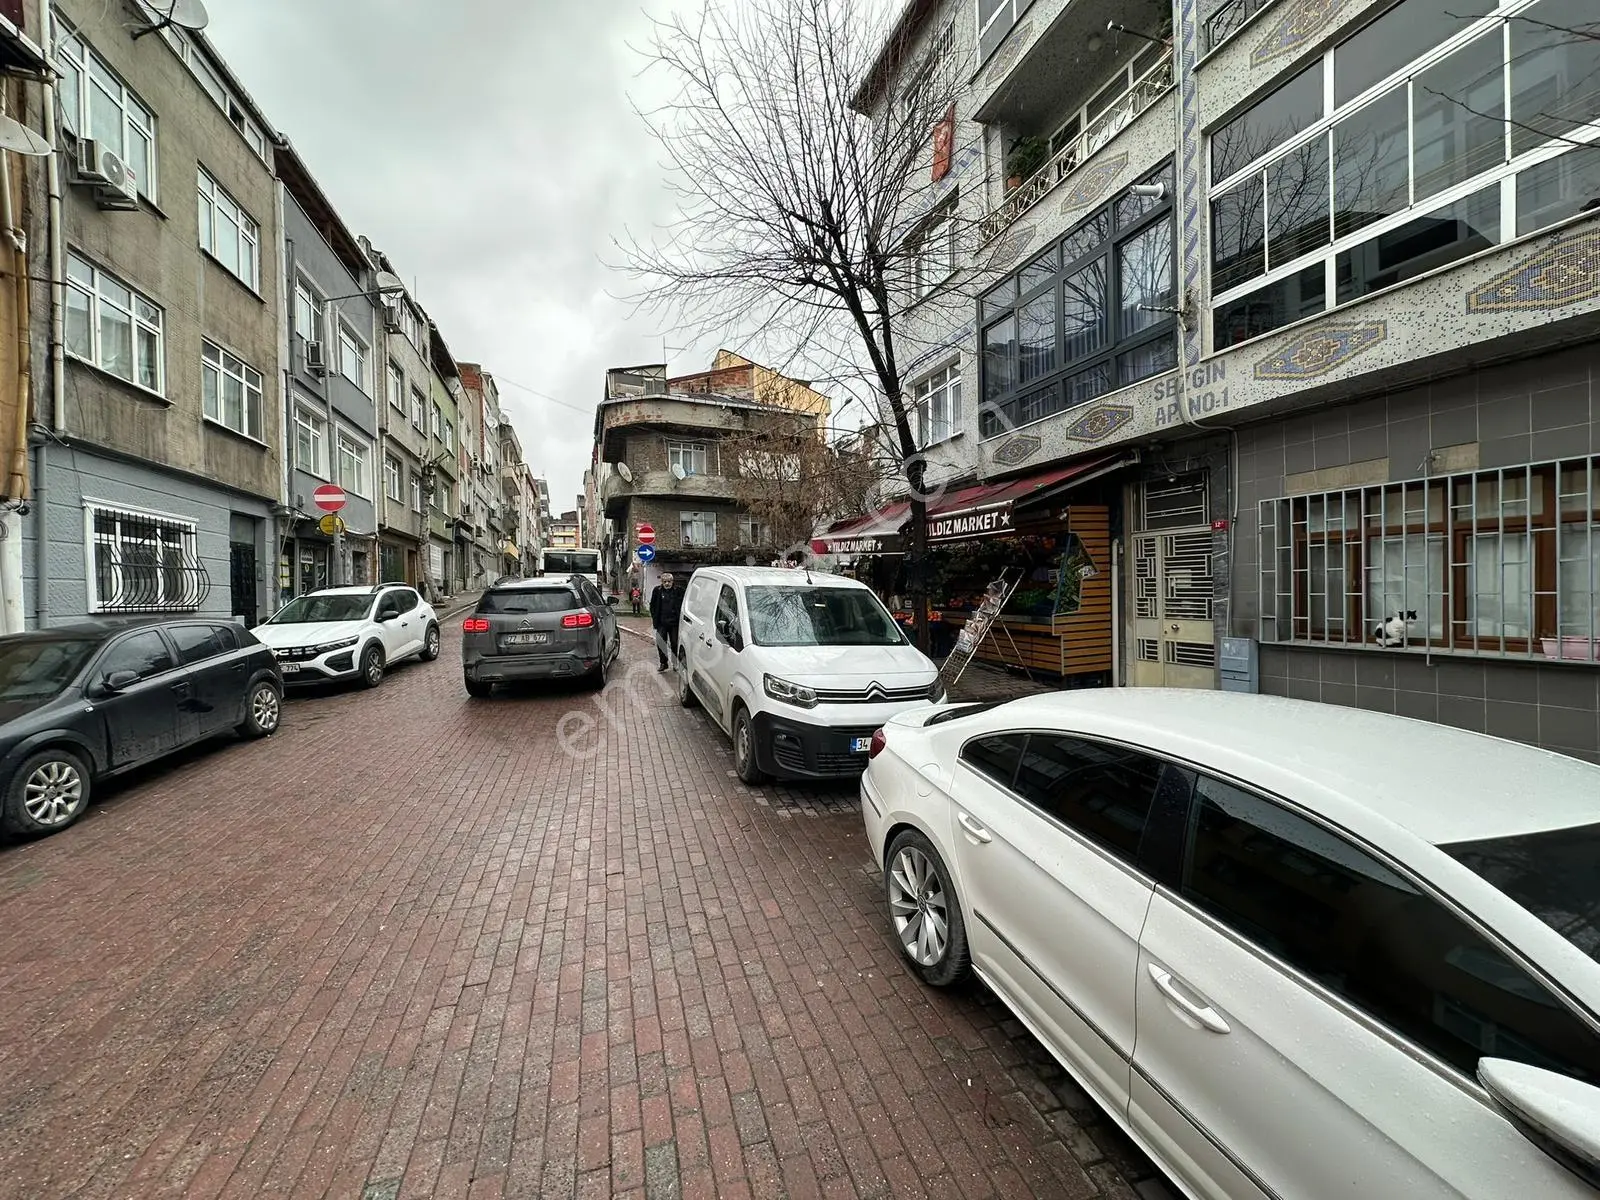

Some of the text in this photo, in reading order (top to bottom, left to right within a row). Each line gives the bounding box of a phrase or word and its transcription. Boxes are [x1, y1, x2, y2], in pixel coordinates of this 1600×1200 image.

[953, 511, 999, 534] MARKET
[850, 539, 876, 552] MARKET
[857, 739, 868, 749] 34
